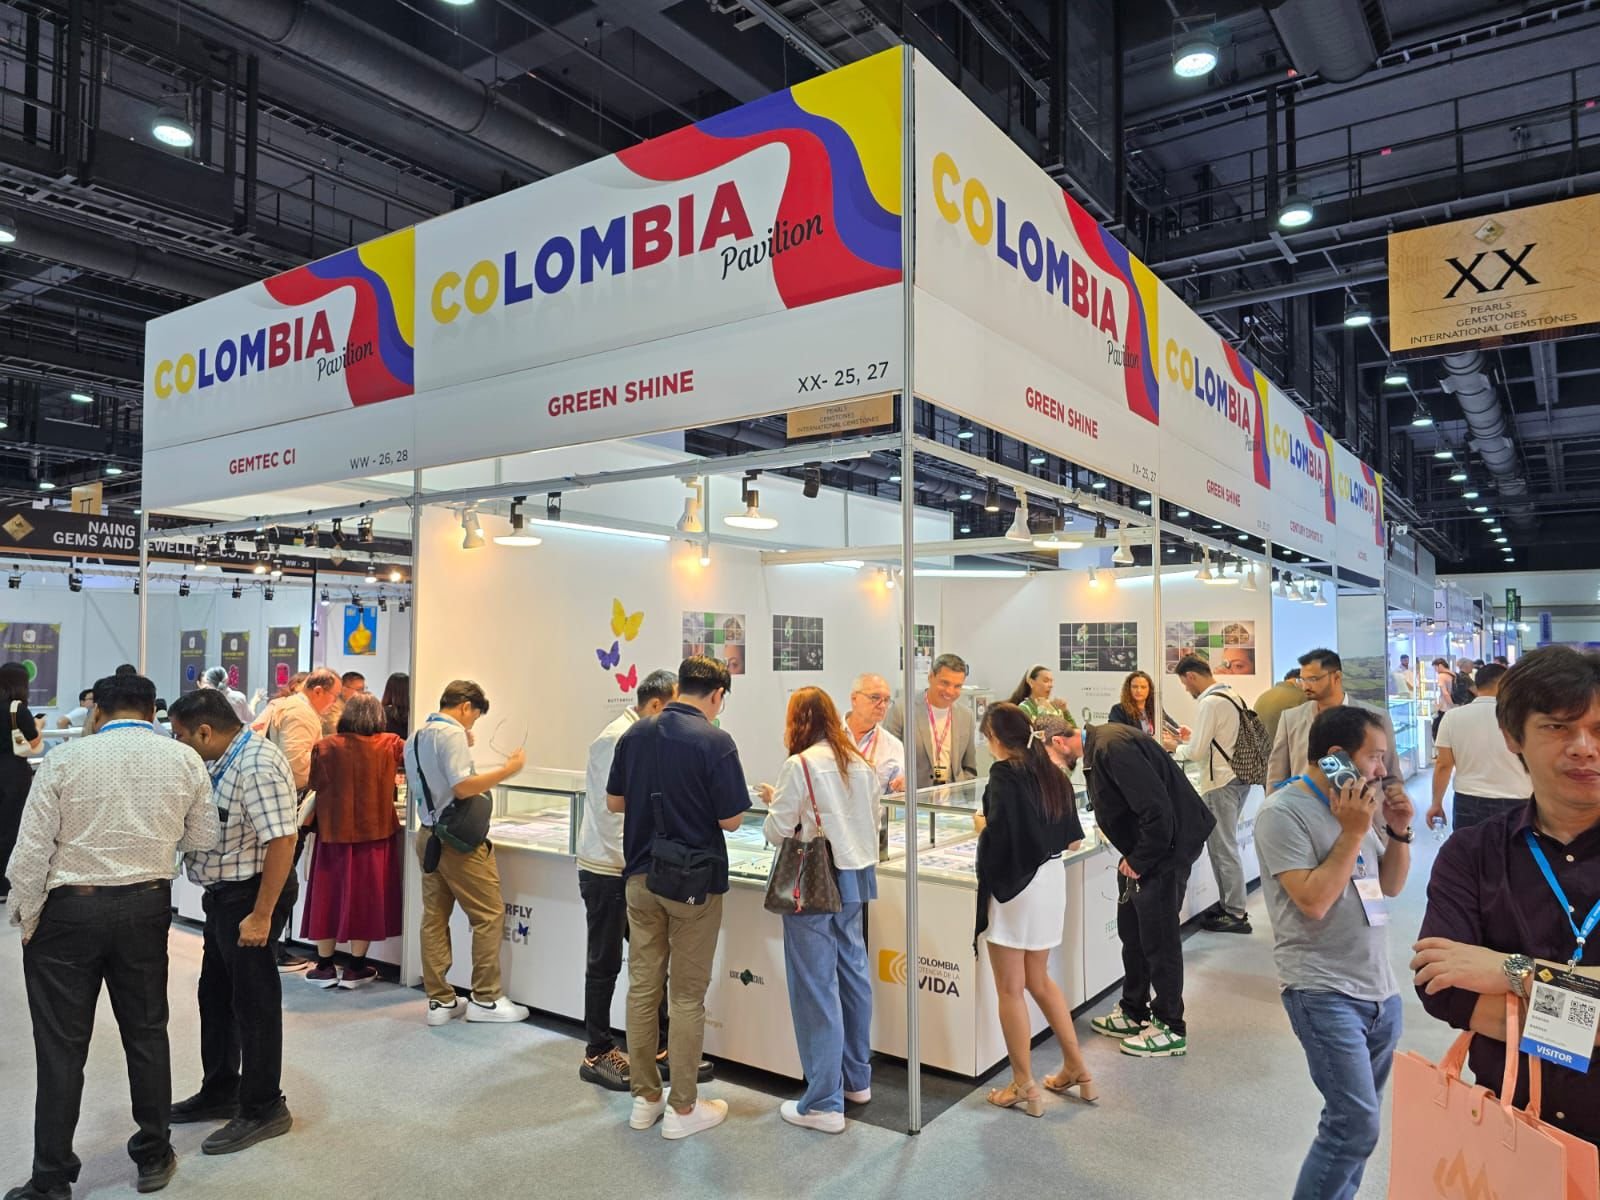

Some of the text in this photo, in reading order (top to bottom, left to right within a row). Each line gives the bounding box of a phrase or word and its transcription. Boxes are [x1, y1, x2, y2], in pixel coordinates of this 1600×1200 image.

[431, 180, 754, 325] COLOMBIA
[721, 213, 824, 280] Pavilion
[933, 152, 1118, 342] COLOMBIA
[1443, 242, 1541, 299] XX
[1456, 309, 1528, 328] GEMSTONES
[1470, 301, 1512, 315] PEARLS
[1410, 312, 1578, 345] INTERNATIONAL GEMSTONES
[154, 310, 335, 400] COLOMBIA
[317, 340, 374, 381] Pavilion
[797, 361, 889, 393] XX- 25, 27
[1166, 338, 1251, 435] COLOMBIA
[548, 369, 694, 417] GREEN SHINE
[797, 416, 879, 432] INTERNATIONAL GEMSTONES
[820, 412, 854, 422] GEMSTONES
[1025, 386, 1098, 439] GREEN SHINE
[229, 448, 296, 475] GEMTEC CI
[350, 456, 370, 470] WW
[379, 452, 394, 466] 26,
[396, 449, 408, 463] 28
[1273, 424, 1324, 485] COLOMBIA
[1207, 479, 1241, 508] GREEN SHINE
[53, 532, 98, 547] GEMS
[102, 537, 135, 550] AND
[88, 521, 136, 537] NAING
[918, 956, 960, 972] OLOMBIA
[919, 975, 960, 997] VIDA
[1536, 1044, 1573, 1064] VISITOR
